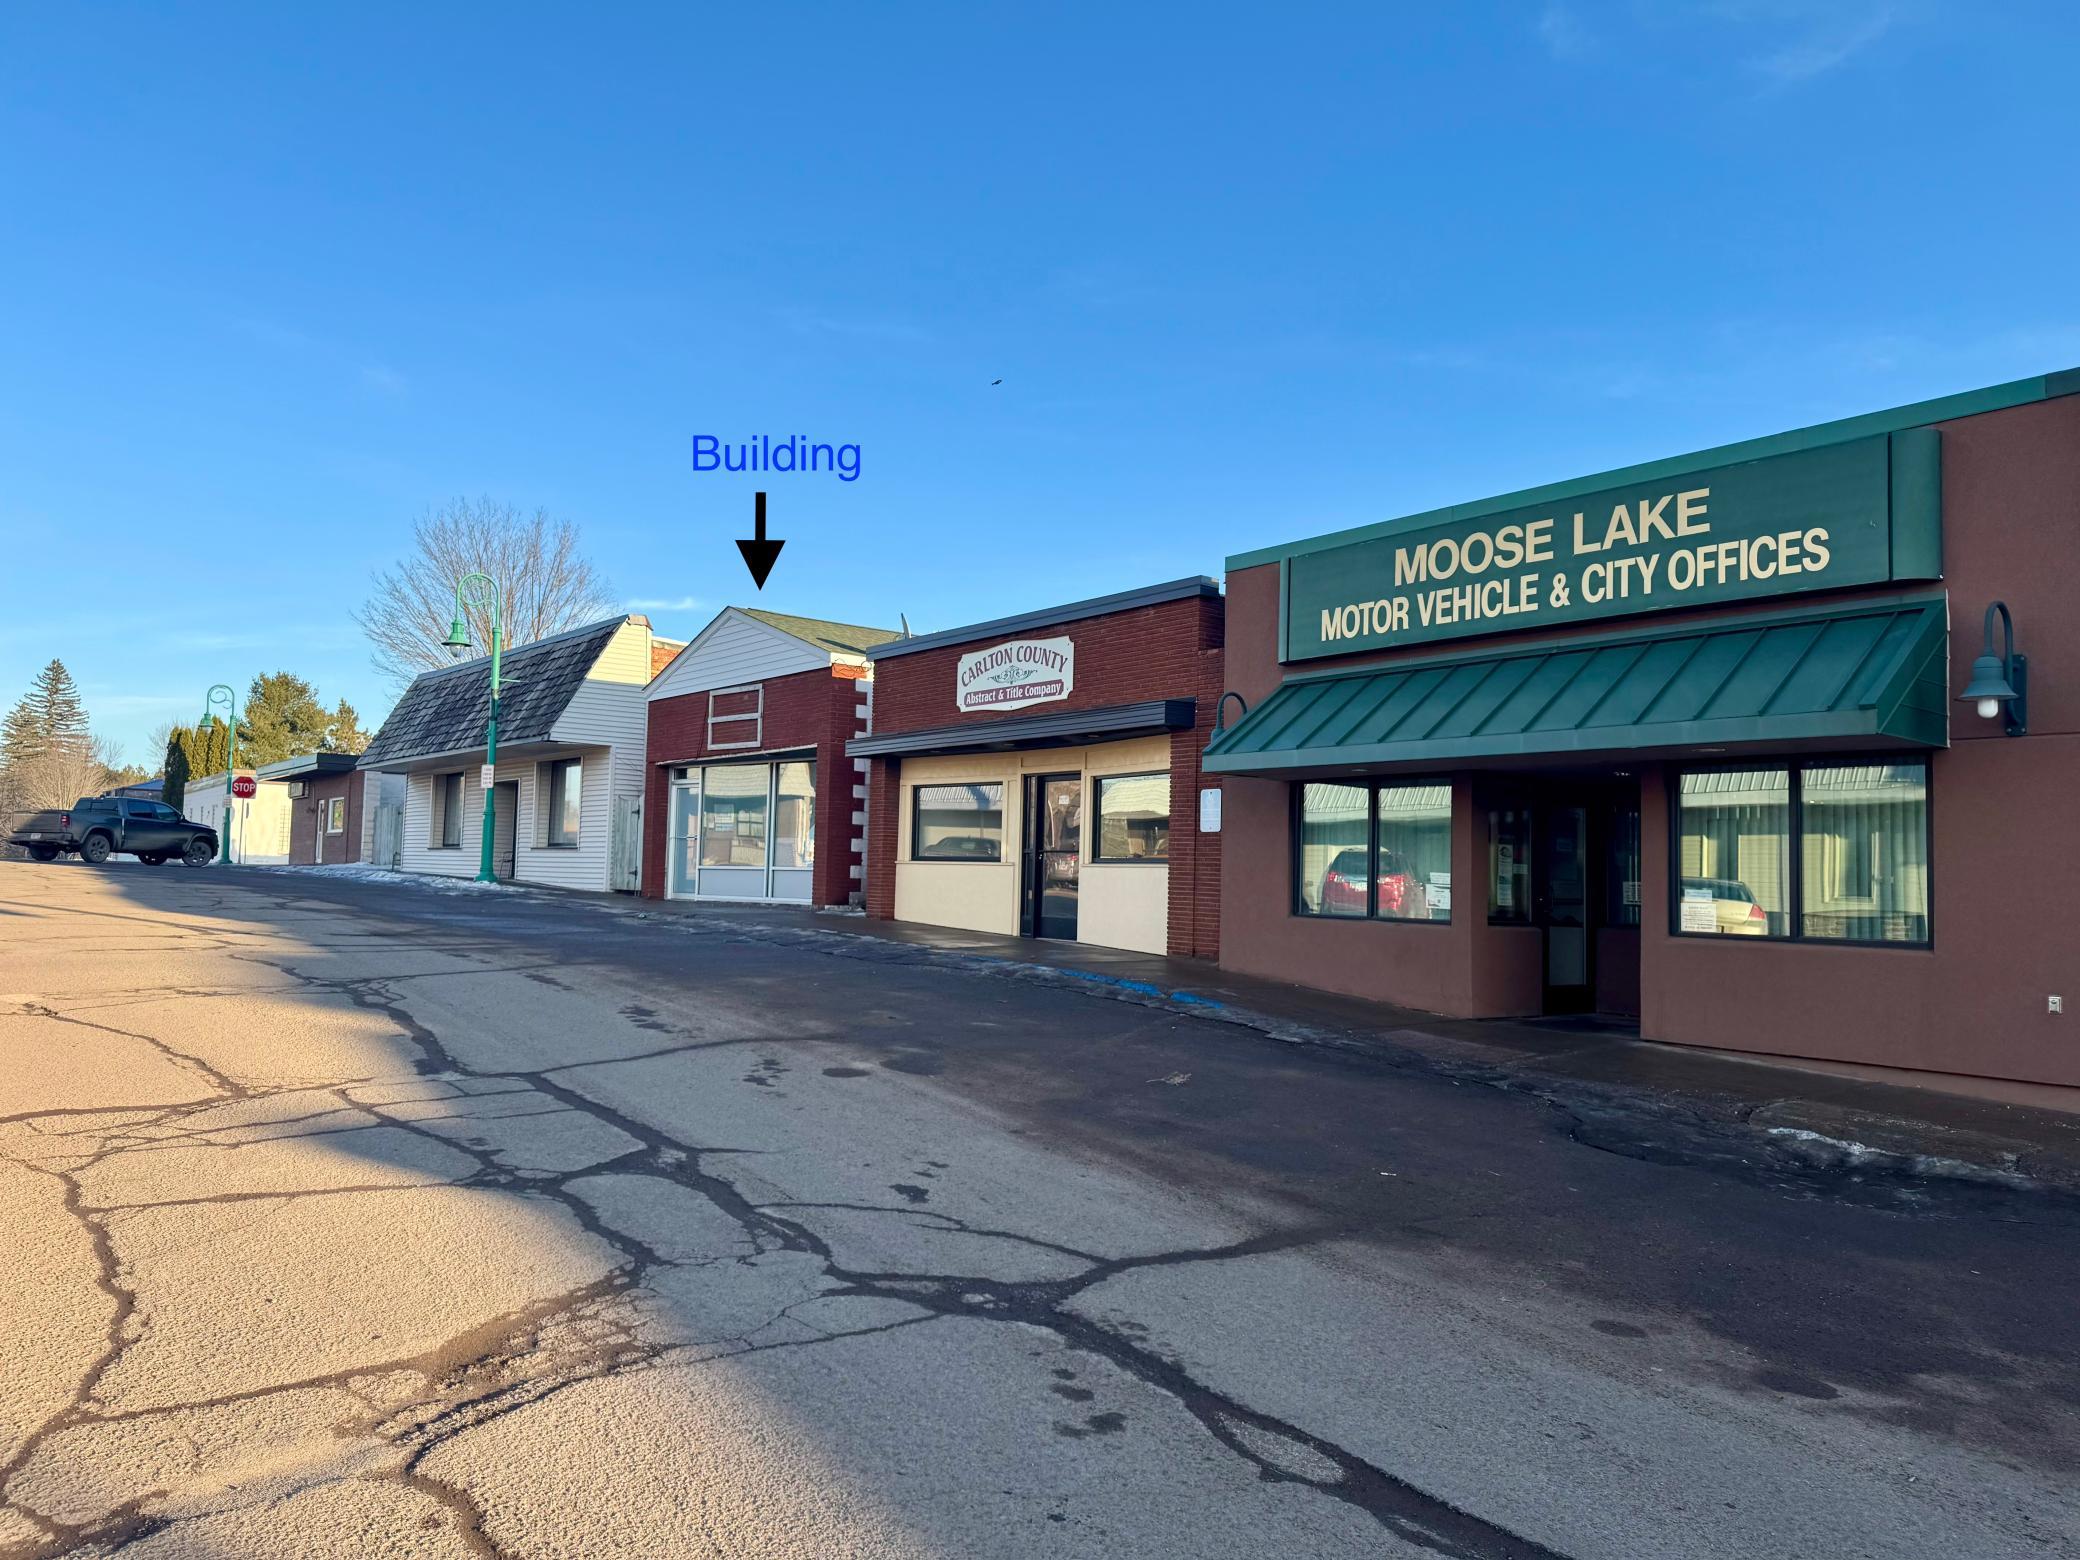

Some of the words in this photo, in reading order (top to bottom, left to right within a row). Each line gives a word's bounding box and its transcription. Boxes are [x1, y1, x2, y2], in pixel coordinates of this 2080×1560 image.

[1394, 519, 1553, 586] MOOSE
[1573, 488, 1710, 555] LAKE
[1321, 596, 1410, 640] MOTOR
[1417, 573, 1538, 625] VEHICLE
[1550, 573, 1570, 607] &
[1581, 554, 1659, 602] CITY
[1668, 527, 1830, 590] OFFICES
[961, 647, 1013, 687] CARLTON
[1016, 645, 1068, 673] COUNTY
[966, 691, 996, 704] Abstract
[998, 690, 1004, 699] &
[1006, 687, 1023, 699] Title
[1024, 682, 1062, 697] Company
[233, 782, 255, 792] STOP
